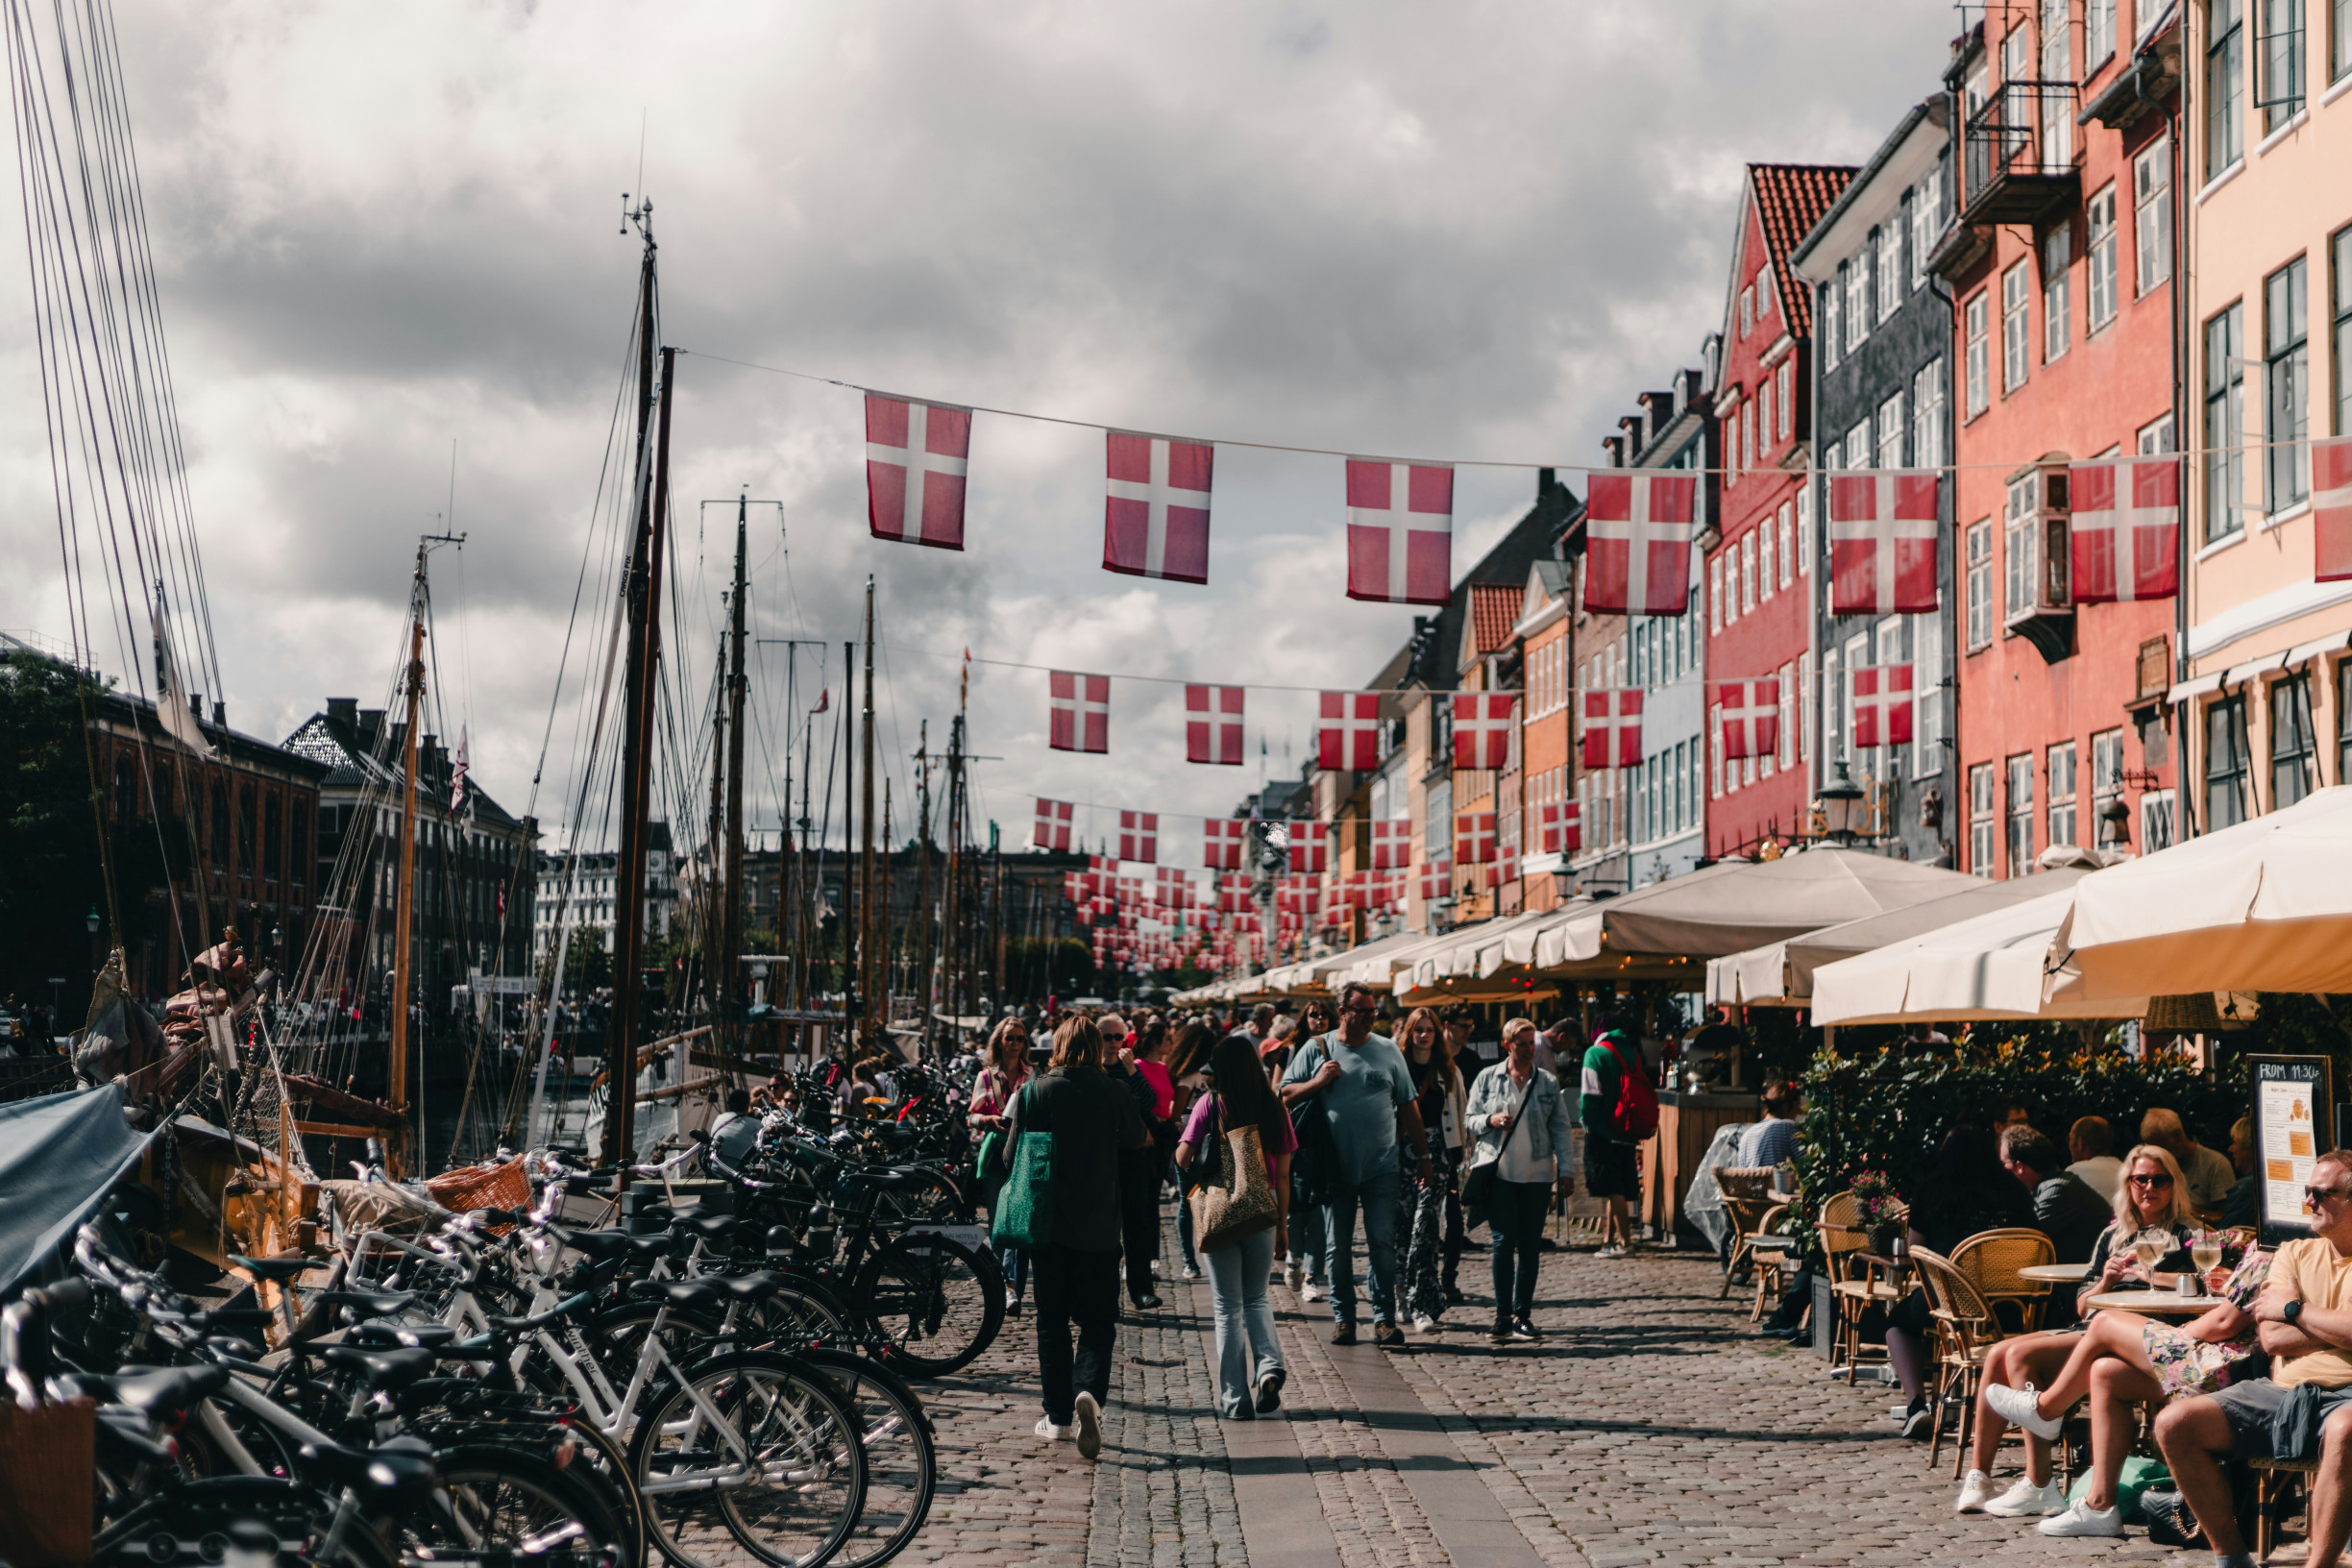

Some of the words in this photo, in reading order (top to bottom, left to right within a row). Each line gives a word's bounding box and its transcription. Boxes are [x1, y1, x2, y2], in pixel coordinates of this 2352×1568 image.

[620, 571, 630, 598] CARGO
[2259, 1064, 2287, 1079] FROM
[565, 1329, 599, 1374] winther
